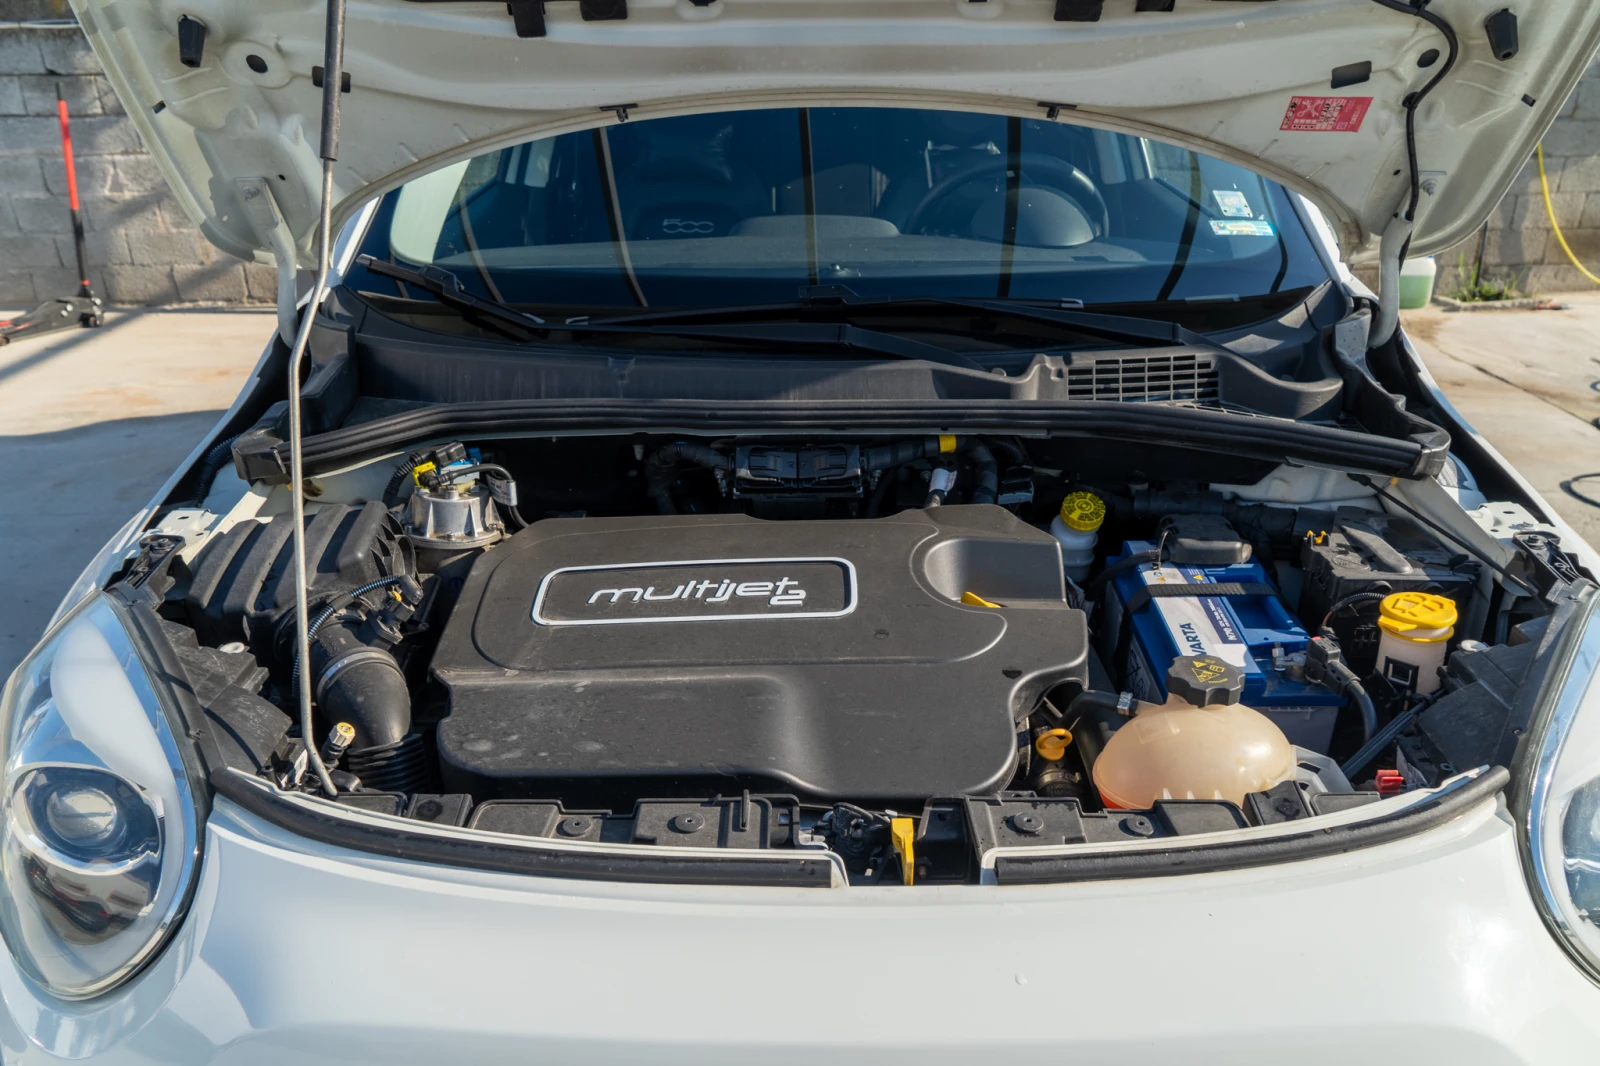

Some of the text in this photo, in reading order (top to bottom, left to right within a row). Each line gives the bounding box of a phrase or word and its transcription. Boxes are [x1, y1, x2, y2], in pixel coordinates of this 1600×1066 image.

[662, 219, 714, 233] 500
[587, 577, 798, 604] multijet
[1180, 622, 1207, 656] VARTA
